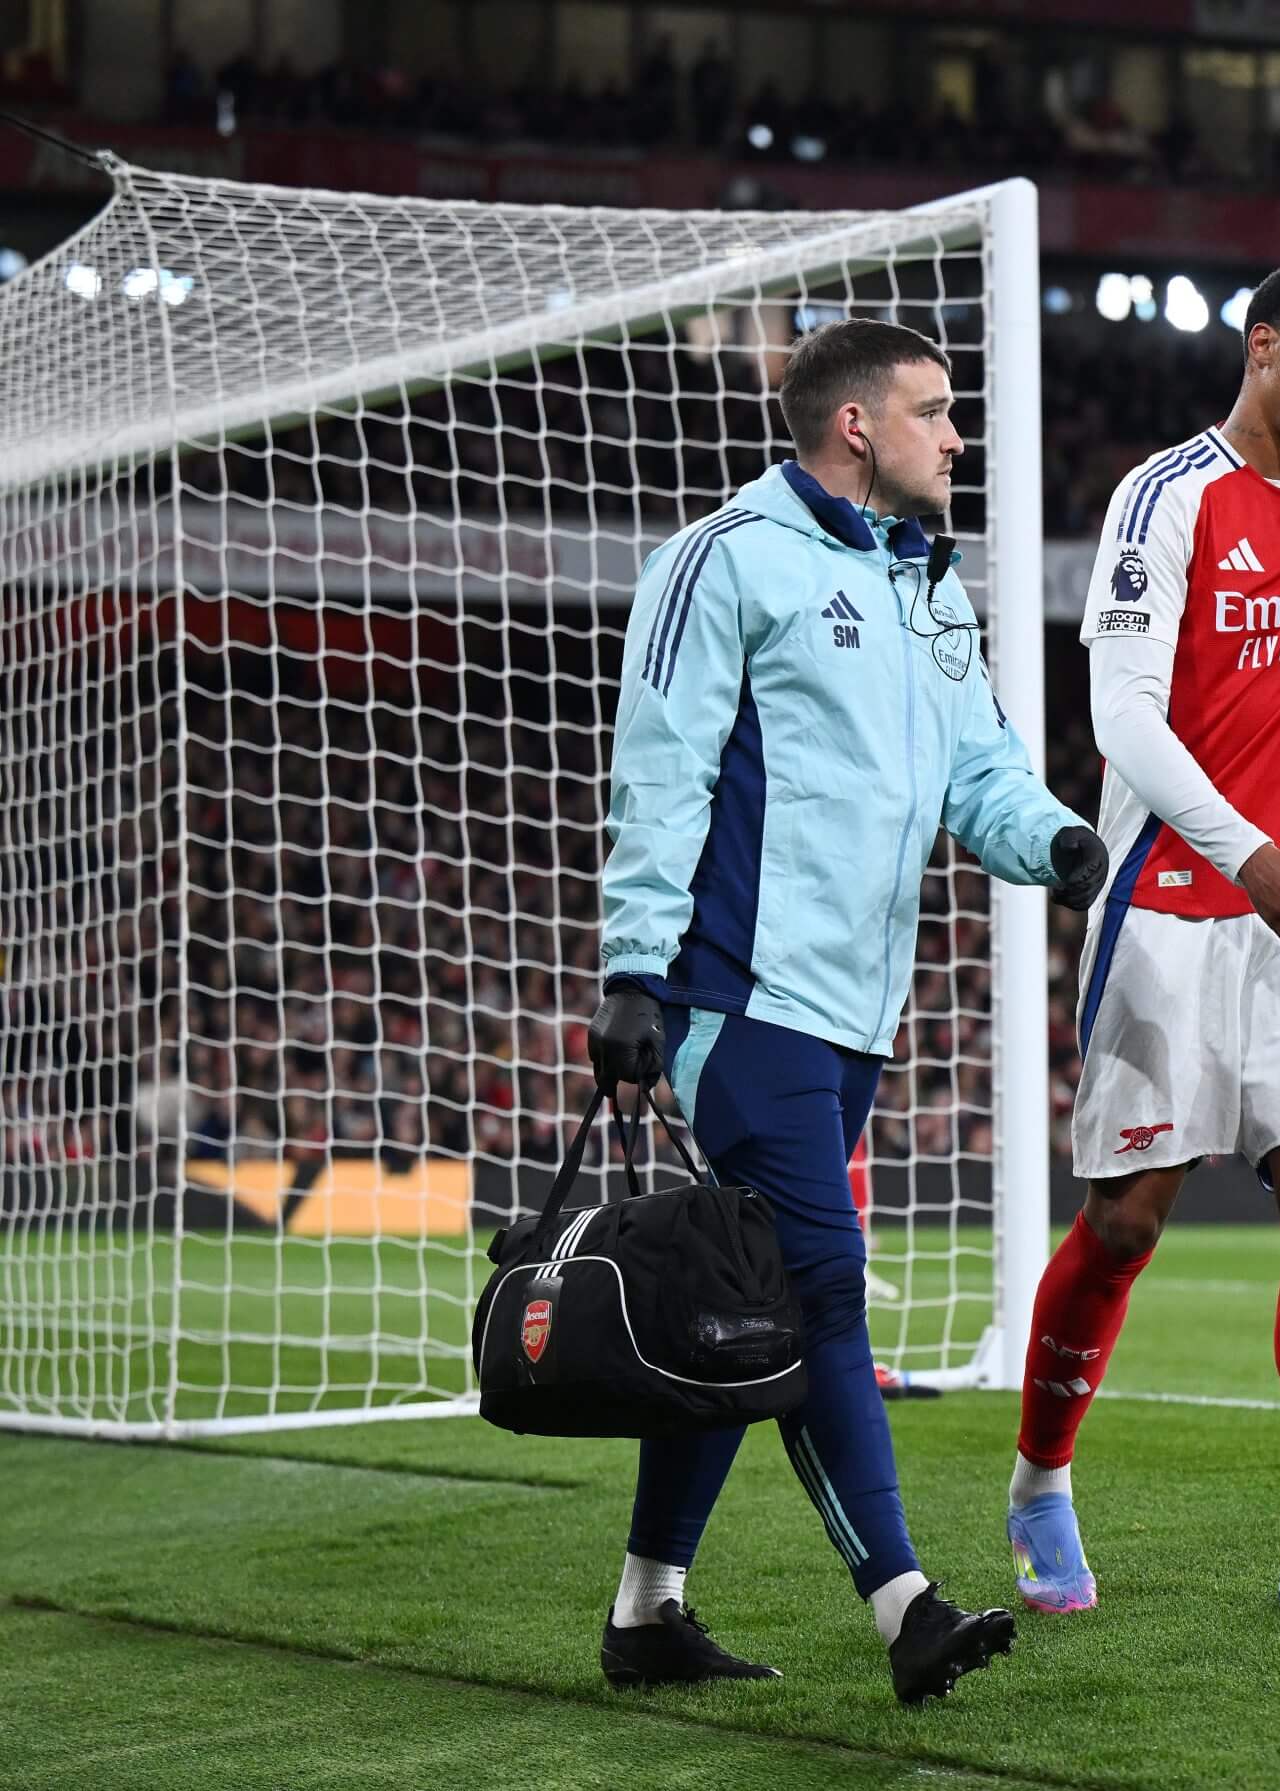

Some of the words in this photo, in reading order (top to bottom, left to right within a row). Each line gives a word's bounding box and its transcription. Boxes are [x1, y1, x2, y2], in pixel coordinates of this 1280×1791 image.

[1111, 612, 1145, 623] room
[833, 624, 861, 649] SM
[1237, 635, 1279, 671] FLY
[1041, 1335, 1101, 1360] AFC
